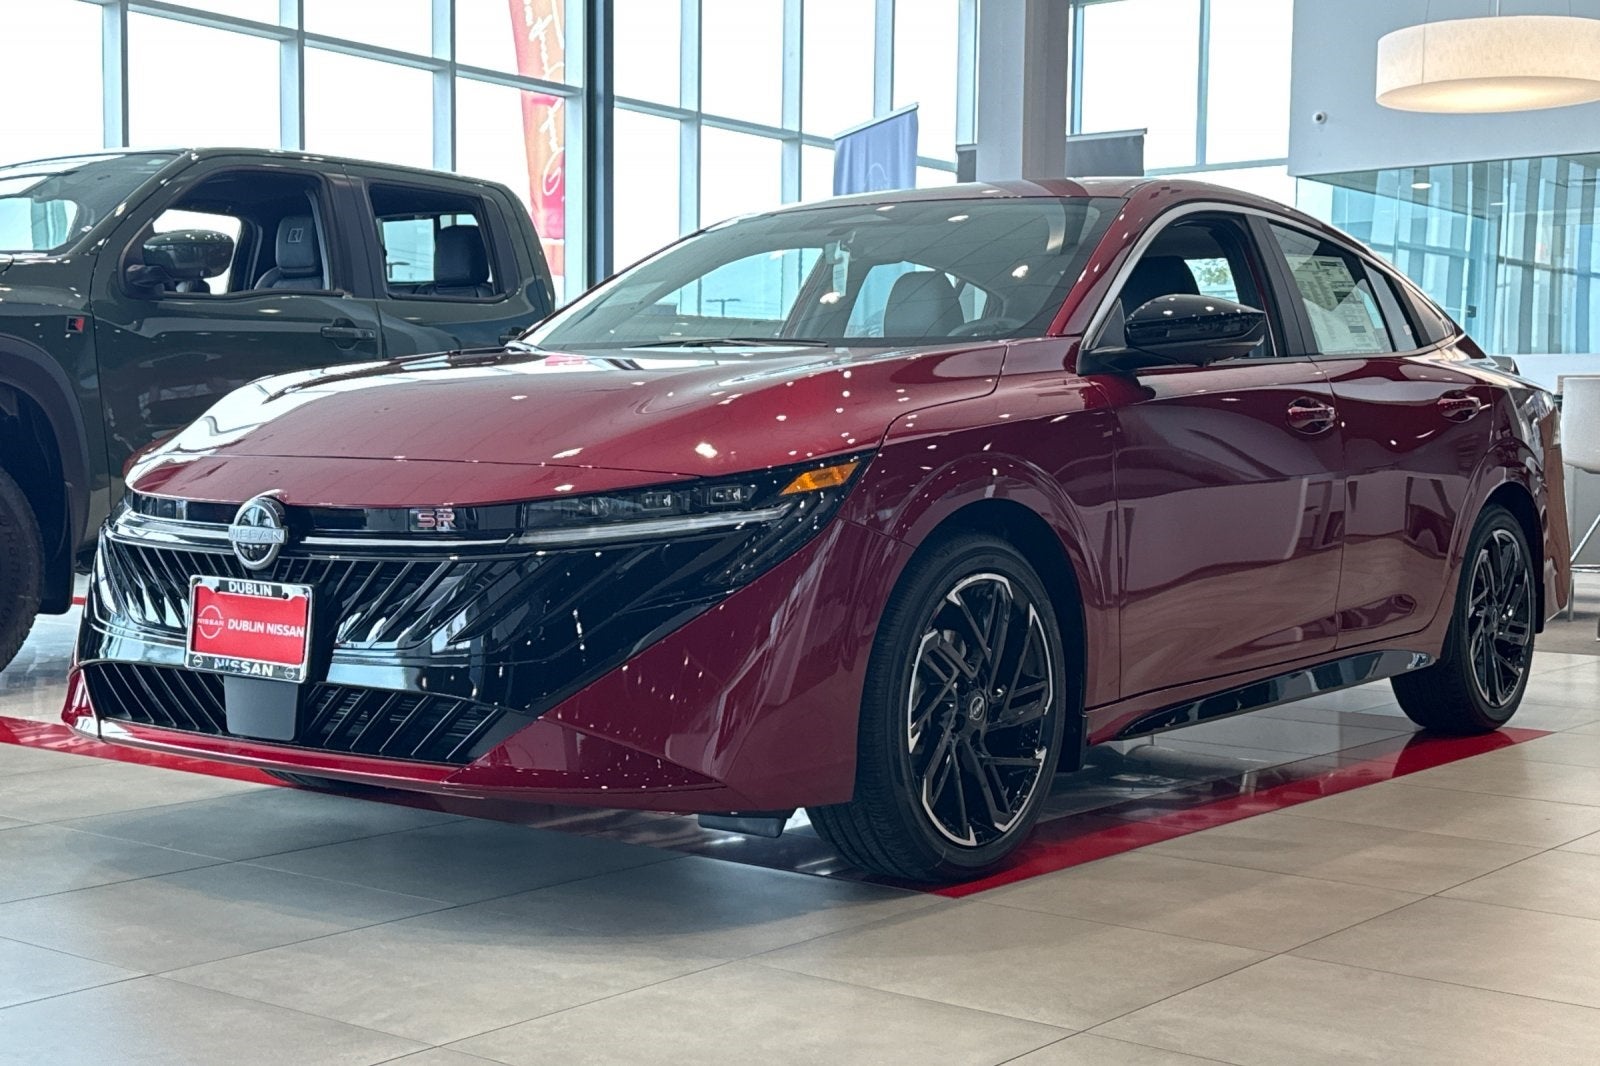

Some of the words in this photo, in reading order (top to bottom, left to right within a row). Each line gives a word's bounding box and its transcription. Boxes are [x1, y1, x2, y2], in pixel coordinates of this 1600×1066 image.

[417, 508, 456, 531] SR
[228, 581, 273, 597] DUBLIN
[197, 618, 224, 627] NISSAN
[227, 618, 265, 634] DUBLIN
[266, 622, 305, 638] NISSAN
[213, 658, 274, 677] NISSAN
